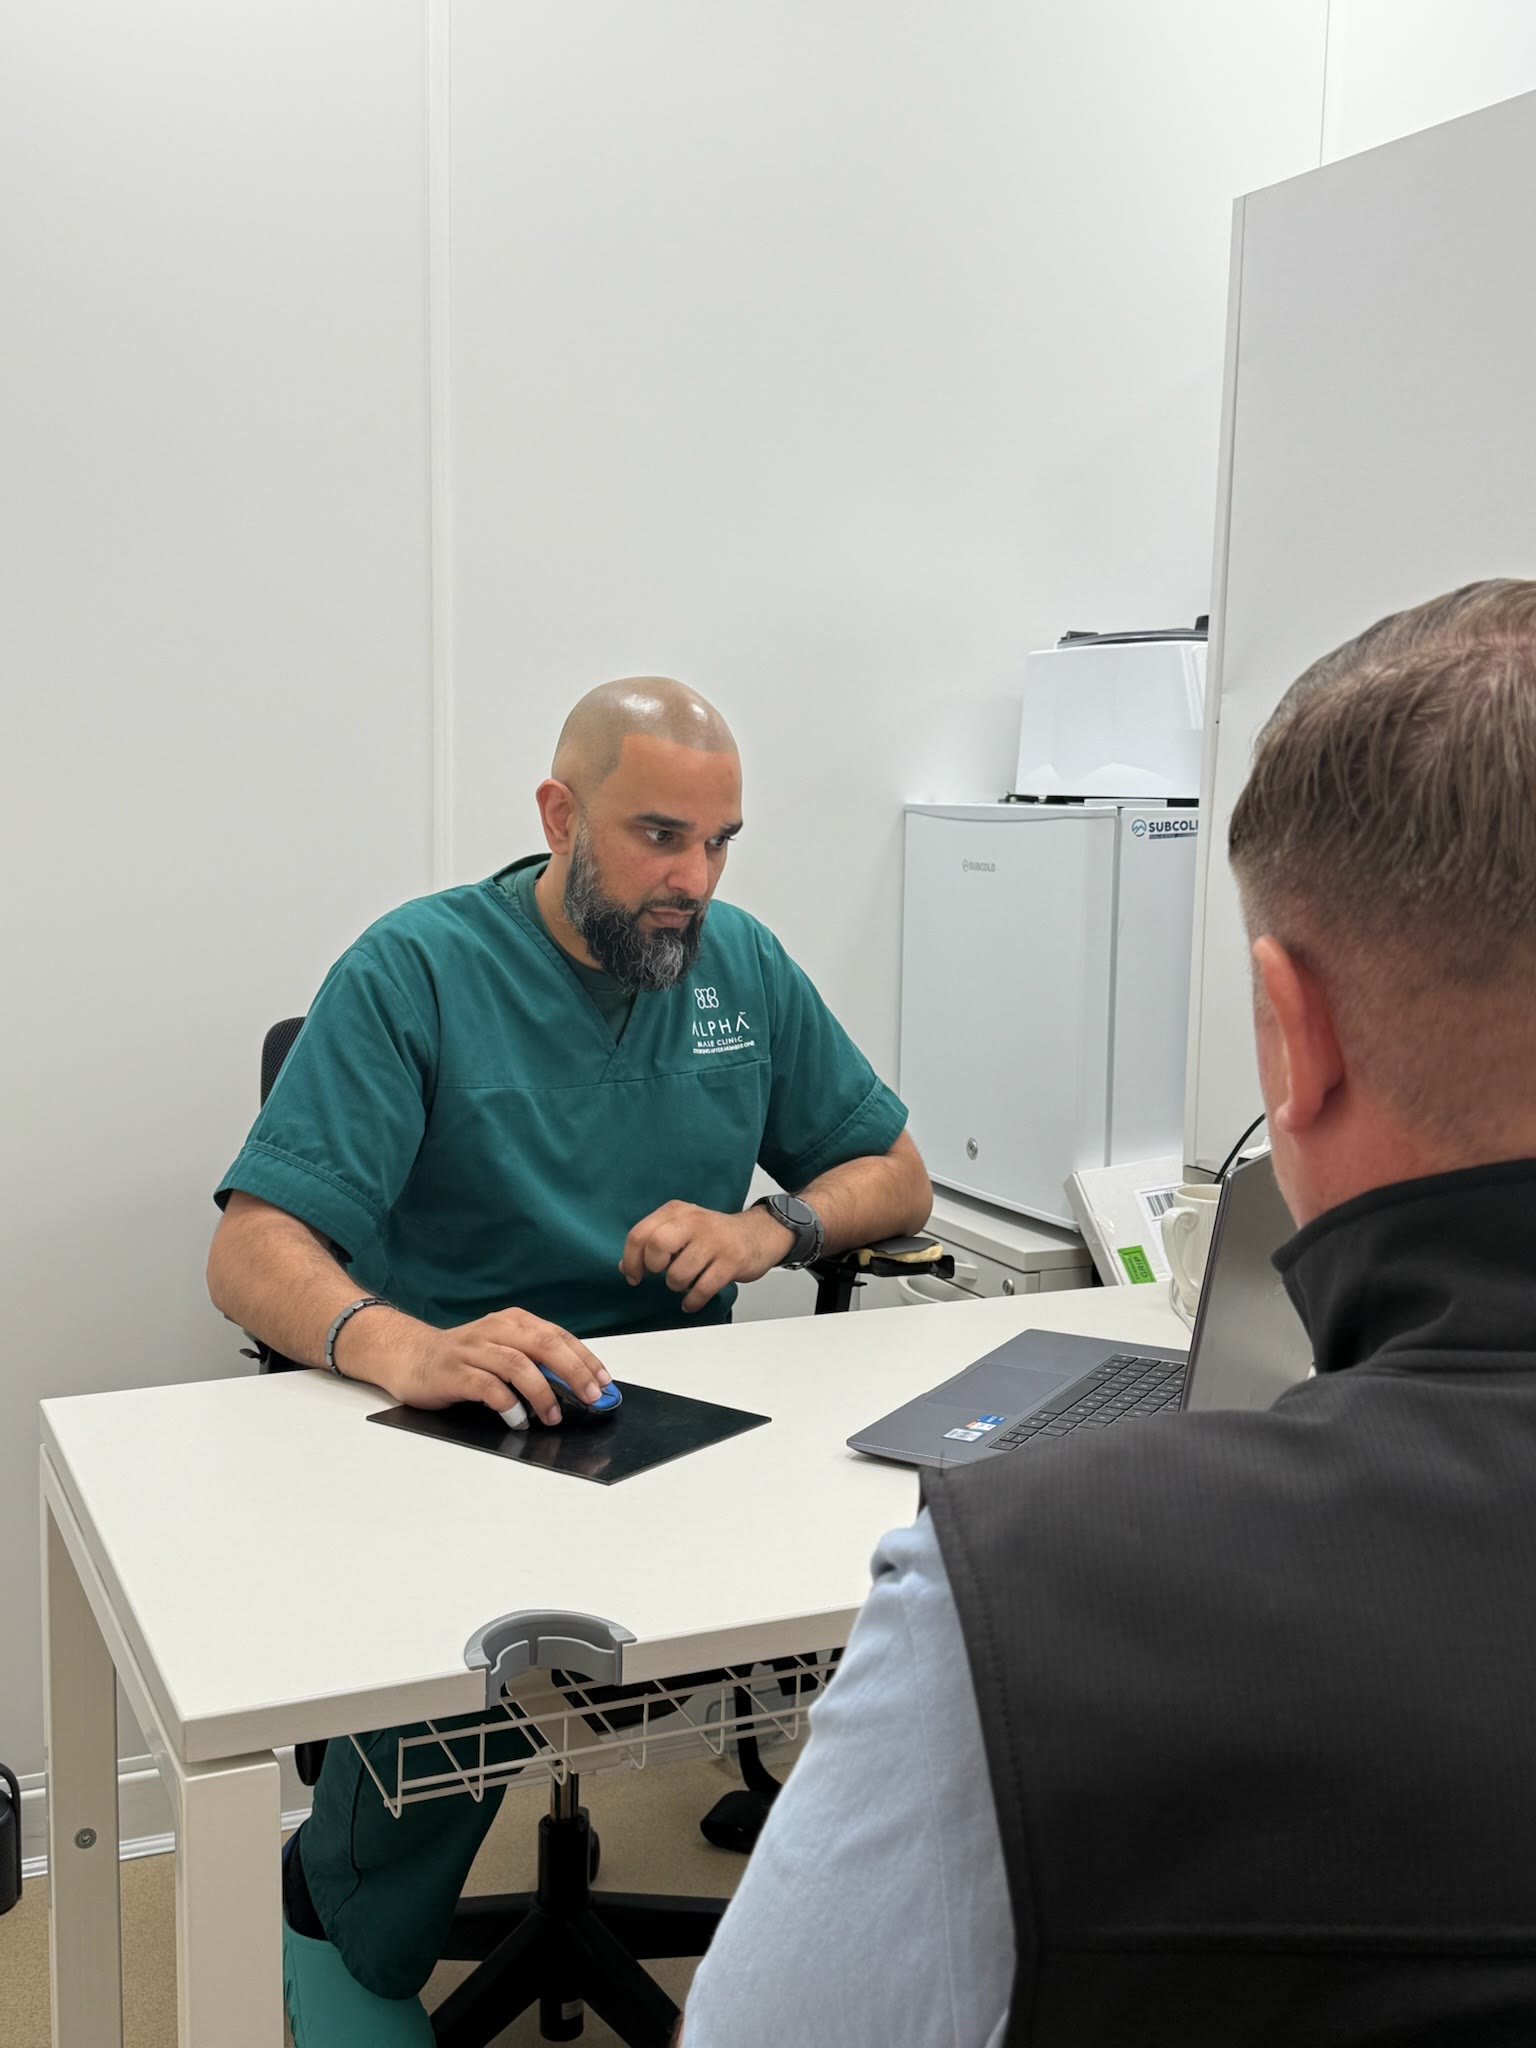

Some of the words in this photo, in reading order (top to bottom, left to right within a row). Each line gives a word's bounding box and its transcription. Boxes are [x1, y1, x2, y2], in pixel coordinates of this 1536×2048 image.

[1149, 820, 1198, 832] SUBCOL
[697, 1040, 715, 1048] MALE
[716, 1036, 743, 1046] CLINIC
[1133, 1256, 1148, 1278] GRIP
